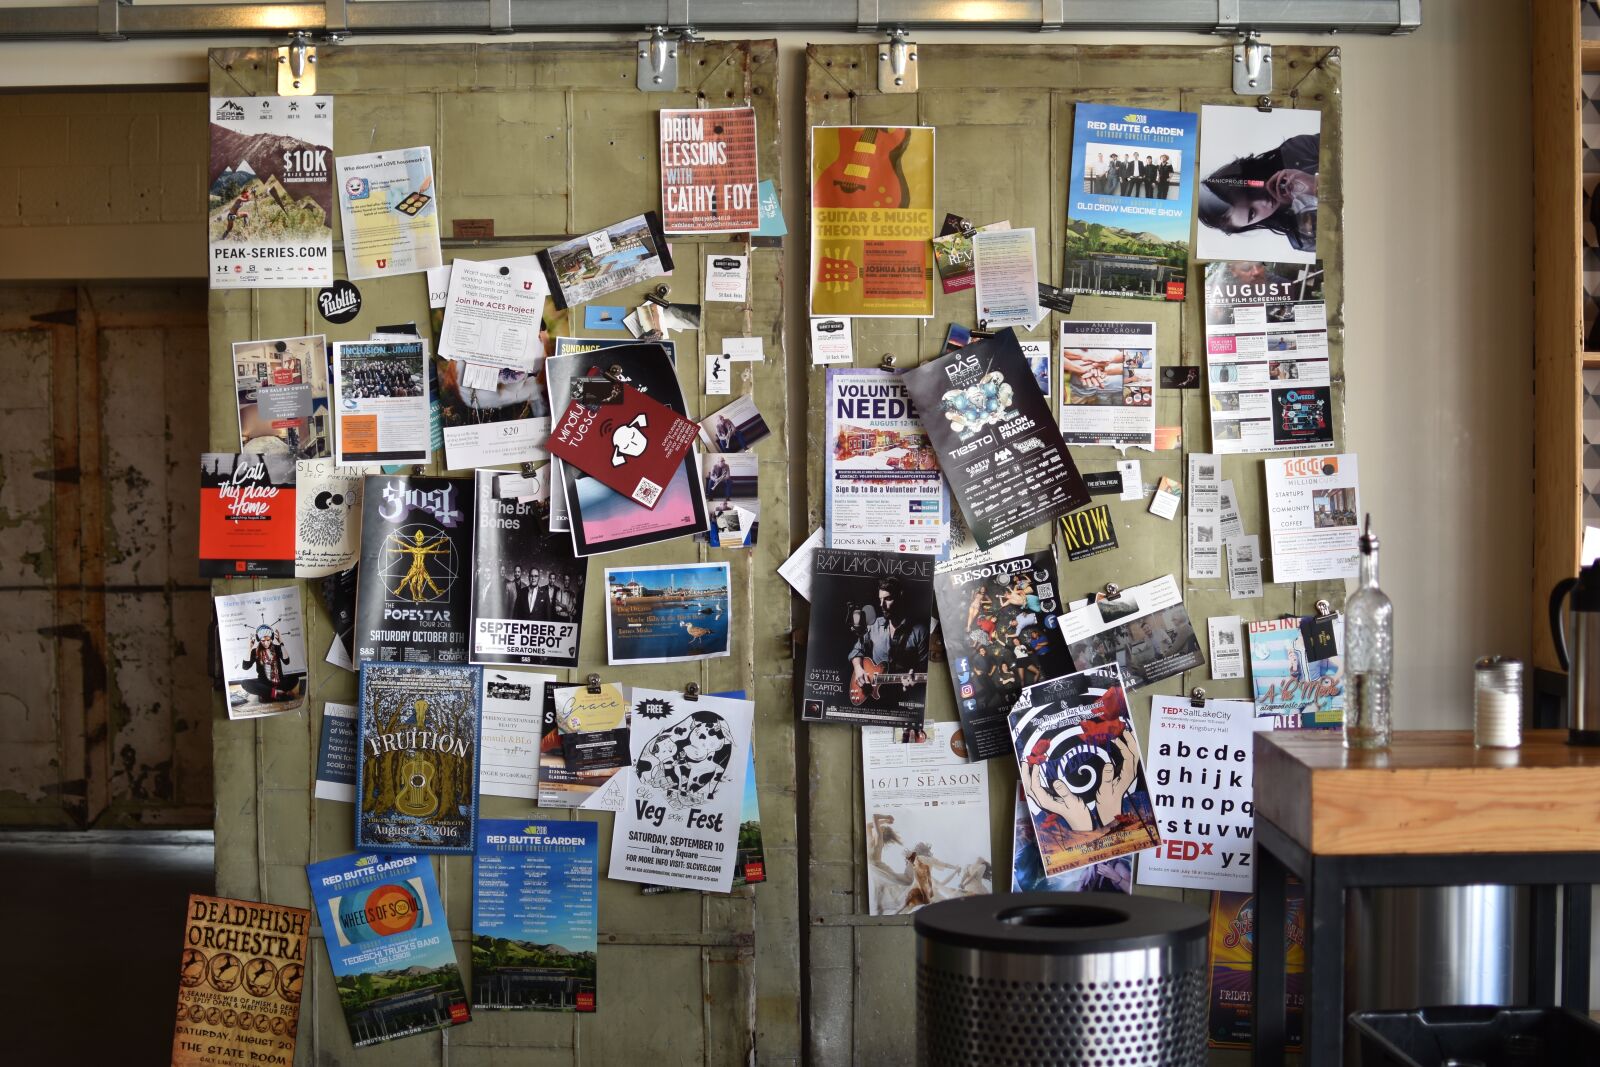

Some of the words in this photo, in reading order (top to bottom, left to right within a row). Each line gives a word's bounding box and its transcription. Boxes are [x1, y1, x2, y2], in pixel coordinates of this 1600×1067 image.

[663, 117, 704, 141] DRUM
[1087, 121, 1107, 130] RED
[1109, 123, 1140, 133] BUTTE
[1143, 126, 1184, 137] GARDEN
[284, 150, 327, 171] $10K
[665, 142, 727, 166] LESSONS
[667, 167, 692, 184] WITH
[668, 185, 715, 211] CATHY
[724, 184, 753, 210] FOY
[817, 211, 868, 223] GUITAR
[871, 212, 880, 223] &
[884, 212, 928, 223] MUSIC
[1077, 202, 1094, 211] OLD
[1094, 204, 1119, 212] CROW
[1120, 206, 1157, 215] MEDICINE
[1158, 208, 1183, 217] SHOW
[816, 225, 871, 236] THEORY
[873, 225, 930, 236] LESSONS
[215, 247, 327, 258] PEAK-SERIES.COM
[1212, 283, 1292, 297] AUGUST
[320, 288, 360, 316] Publik.
[486, 302, 505, 310] ACES
[944, 354, 978, 376] DAS
[837, 398, 920, 419] NEEDE
[503, 427, 518, 436] $20
[998, 415, 1028, 433] DILLON
[1001, 419, 1036, 439] FRANCIS
[233, 462, 265, 485] Call
[298, 462, 324, 473] SLC
[333, 466, 368, 476] PINK
[966, 458, 990, 472] GARETH
[218, 482, 240, 499] this
[242, 483, 279, 500] place
[835, 485, 850, 493] Sign
[919, 486, 940, 494] Today!
[228, 500, 270, 520] Home
[492, 502, 514, 515] The
[480, 515, 520, 529] Bones
[1061, 506, 1110, 550] NOW
[817, 555, 839, 570] RAY
[843, 557, 931, 577] LAMONTAGNE
[952, 558, 1033, 586] RESOLVED
[384, 609, 450, 621] POPESTAR
[370, 630, 411, 641] SATURDAY
[413, 632, 448, 642] OCTOBER
[450, 632, 464, 643] 8TH
[480, 622, 554, 636] SEPTEMBER
[560, 626, 573, 637] 27
[490, 634, 515, 645] THE
[520, 636, 562, 648] DEPOT
[810, 673, 840, 682] 09.17.16
[813, 684, 843, 692] CAPITOL
[562, 697, 619, 719] Grace
[646, 704, 663, 714] FREE
[1189, 725, 1216, 734] Kingsbury
[368, 730, 470, 758] FRUITION
[871, 777, 909, 789] 16/17
[917, 774, 982, 787] SEASON
[635, 799, 666, 826] Veg
[686, 808, 723, 832] Fest
[374, 825, 410, 836] August
[433, 826, 457, 837] 2016
[486, 835, 507, 844] RED
[509, 836, 541, 844] BUTTE
[543, 837, 585, 846] GARDEN
[628, 831, 668, 846] SATURDAY,
[670, 835, 713, 851] SEPTEMBER
[716, 843, 724, 852] 10
[652, 846, 674, 858] Library
[676, 847, 698, 859] Square
[322, 875, 342, 886] RED
[344, 866, 375, 881] BUTTE
[377, 856, 417, 873] GARDEN
[626, 854, 637, 862] FOR
[638, 855, 654, 864] MORE
[656, 856, 668, 865] INFO
[670, 859, 685, 868] VISIT:
[686, 861, 721, 873] SLCVEG.COM
[192, 900, 306, 935] DEADPHISH
[341, 906, 376, 928] WHEELS
[376, 903, 389, 920] OF
[390, 898, 421, 918] SOUL
[188, 925, 303, 960] ORCHESTRA
[342, 951, 383, 966] TEDESCHI
[383, 943, 416, 957] TRUCKS
[418, 936, 440, 948] BAND
[374, 957, 388, 965] LOS
[389, 952, 412, 962] LOBOS
[186, 991, 222, 1001] SEAMLESS
[252, 999, 272, 1008] PHISH
[280, 1004, 298, 1012] DEAD
[193, 996, 211, 1004] SPLIT
[212, 998, 231, 1008] OPEN
[241, 1003, 257, 1011] MELT
[259, 1006, 278, 1014] YOUR
[280, 1008, 297, 1017] FACE
[175, 1027, 230, 1041] SATURDAY,
[235, 1035, 274, 1047] AUGUST
[278, 1041, 292, 1049] 20
[180, 1042, 202, 1052] THE
[207, 1046, 244, 1058] STATE
[250, 1051, 286, 1065] ROOM
